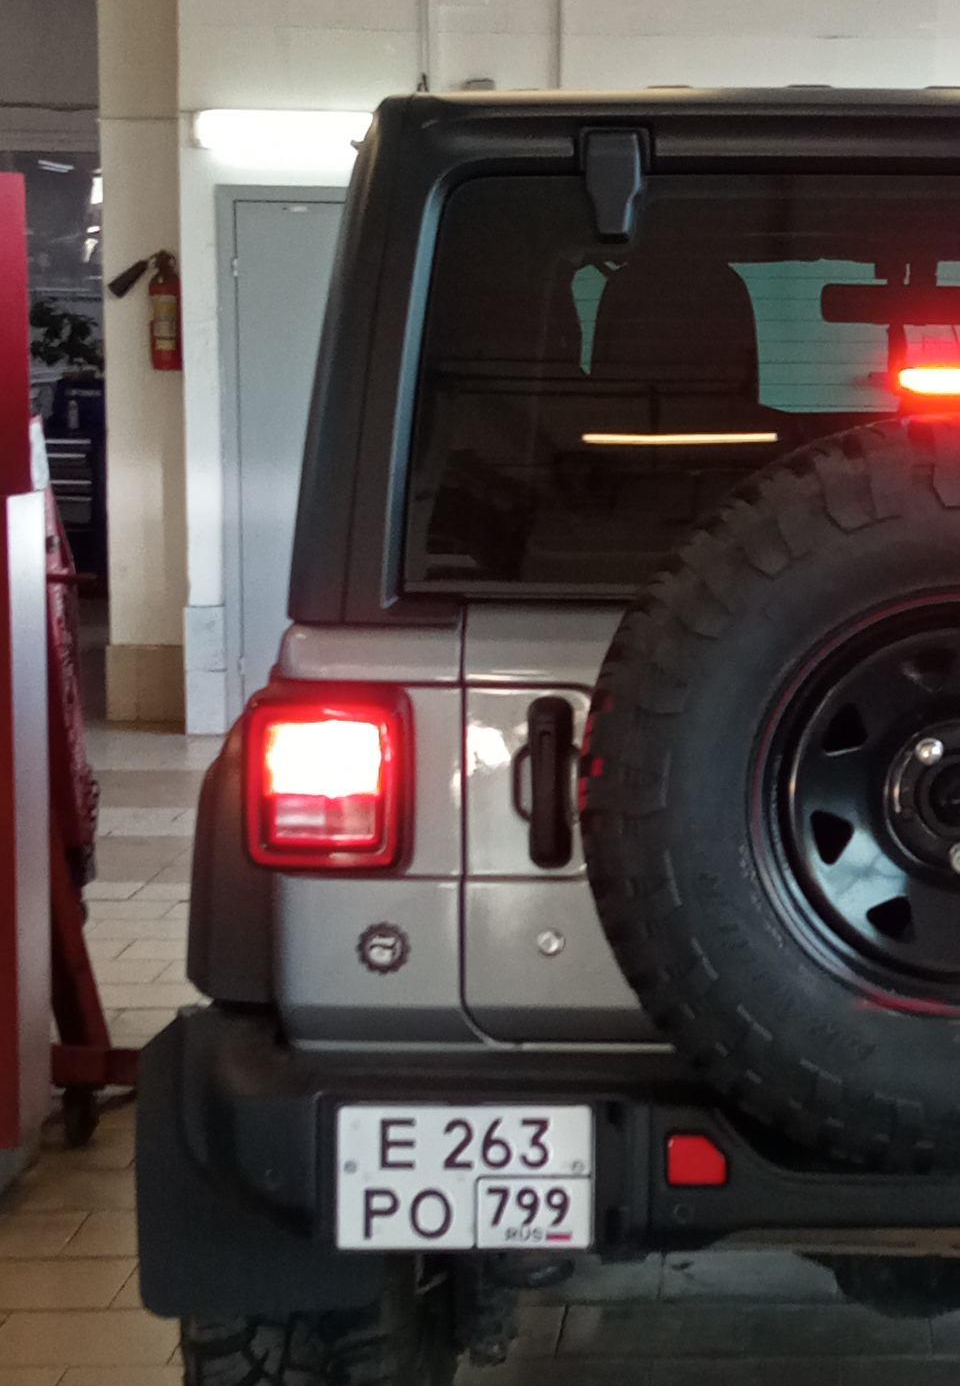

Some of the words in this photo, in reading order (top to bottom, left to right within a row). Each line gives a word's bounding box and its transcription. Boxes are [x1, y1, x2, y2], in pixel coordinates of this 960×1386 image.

[443, 1117, 550, 1170] 263
[487, 1186, 570, 1226] 799
[505, 1227, 543, 1242] RUS
